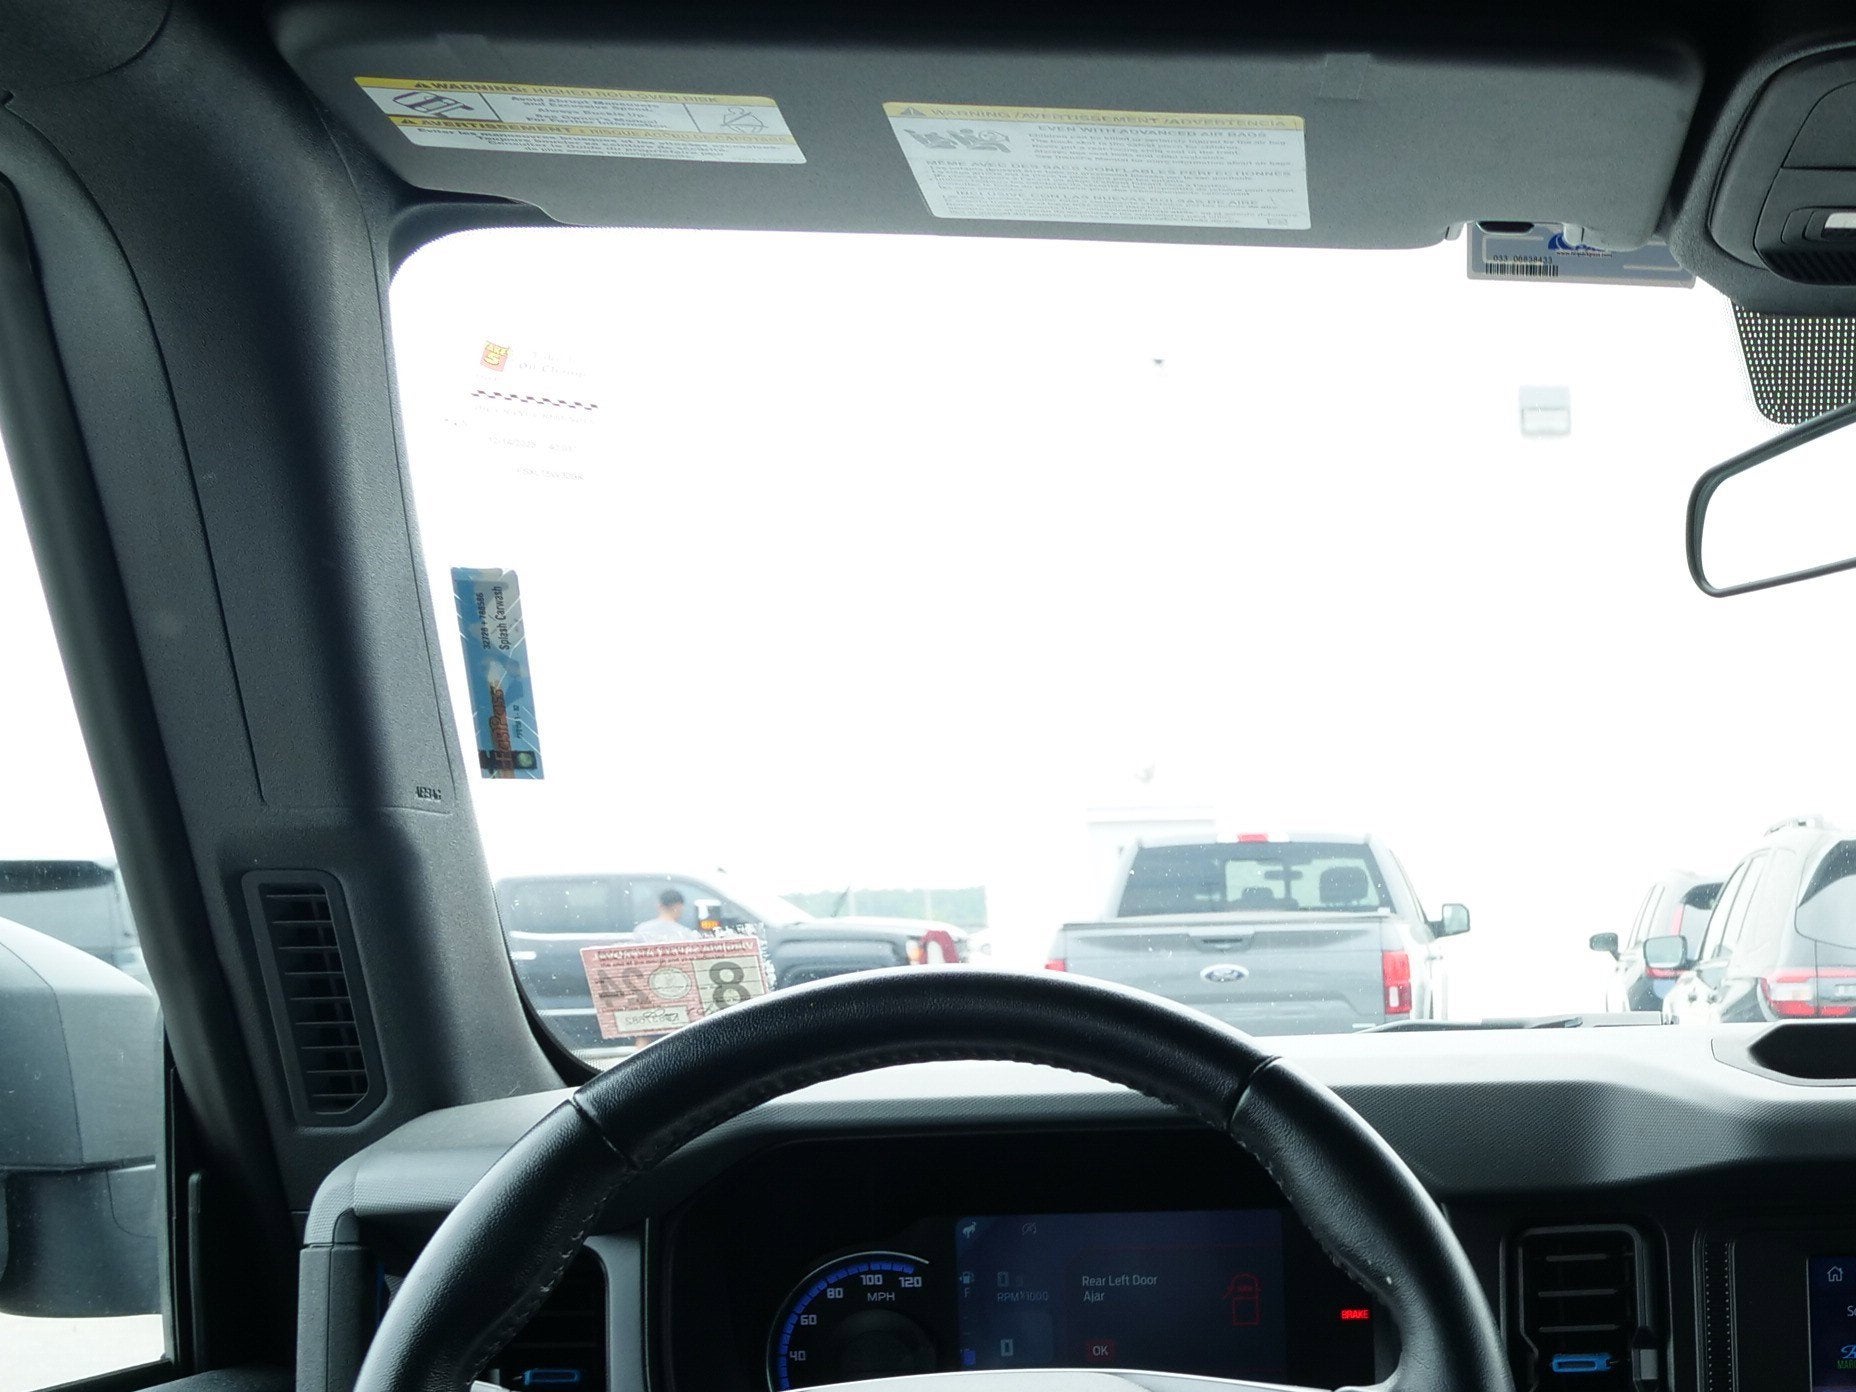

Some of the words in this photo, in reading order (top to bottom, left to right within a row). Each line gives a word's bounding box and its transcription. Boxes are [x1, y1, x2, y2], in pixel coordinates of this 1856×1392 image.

[492, 585, 506, 622] Carwash
[498, 623, 510, 651] Splash
[860, 1275, 883, 1286] 100
[899, 1276, 922, 1288] 120
[1082, 1275, 1107, 1287] Rear
[1109, 1274, 1130, 1286] Left
[1132, 1274, 1158, 1286] Door
[827, 1288, 844, 1299] 80
[867, 1292, 895, 1301] MPH
[1083, 1291, 1105, 1303] Ajar
[1341, 1309, 1370, 1319] BRAKE
[801, 1314, 818, 1326] 60
[789, 1350, 806, 1361] 40
[1092, 1345, 1109, 1356] OK
